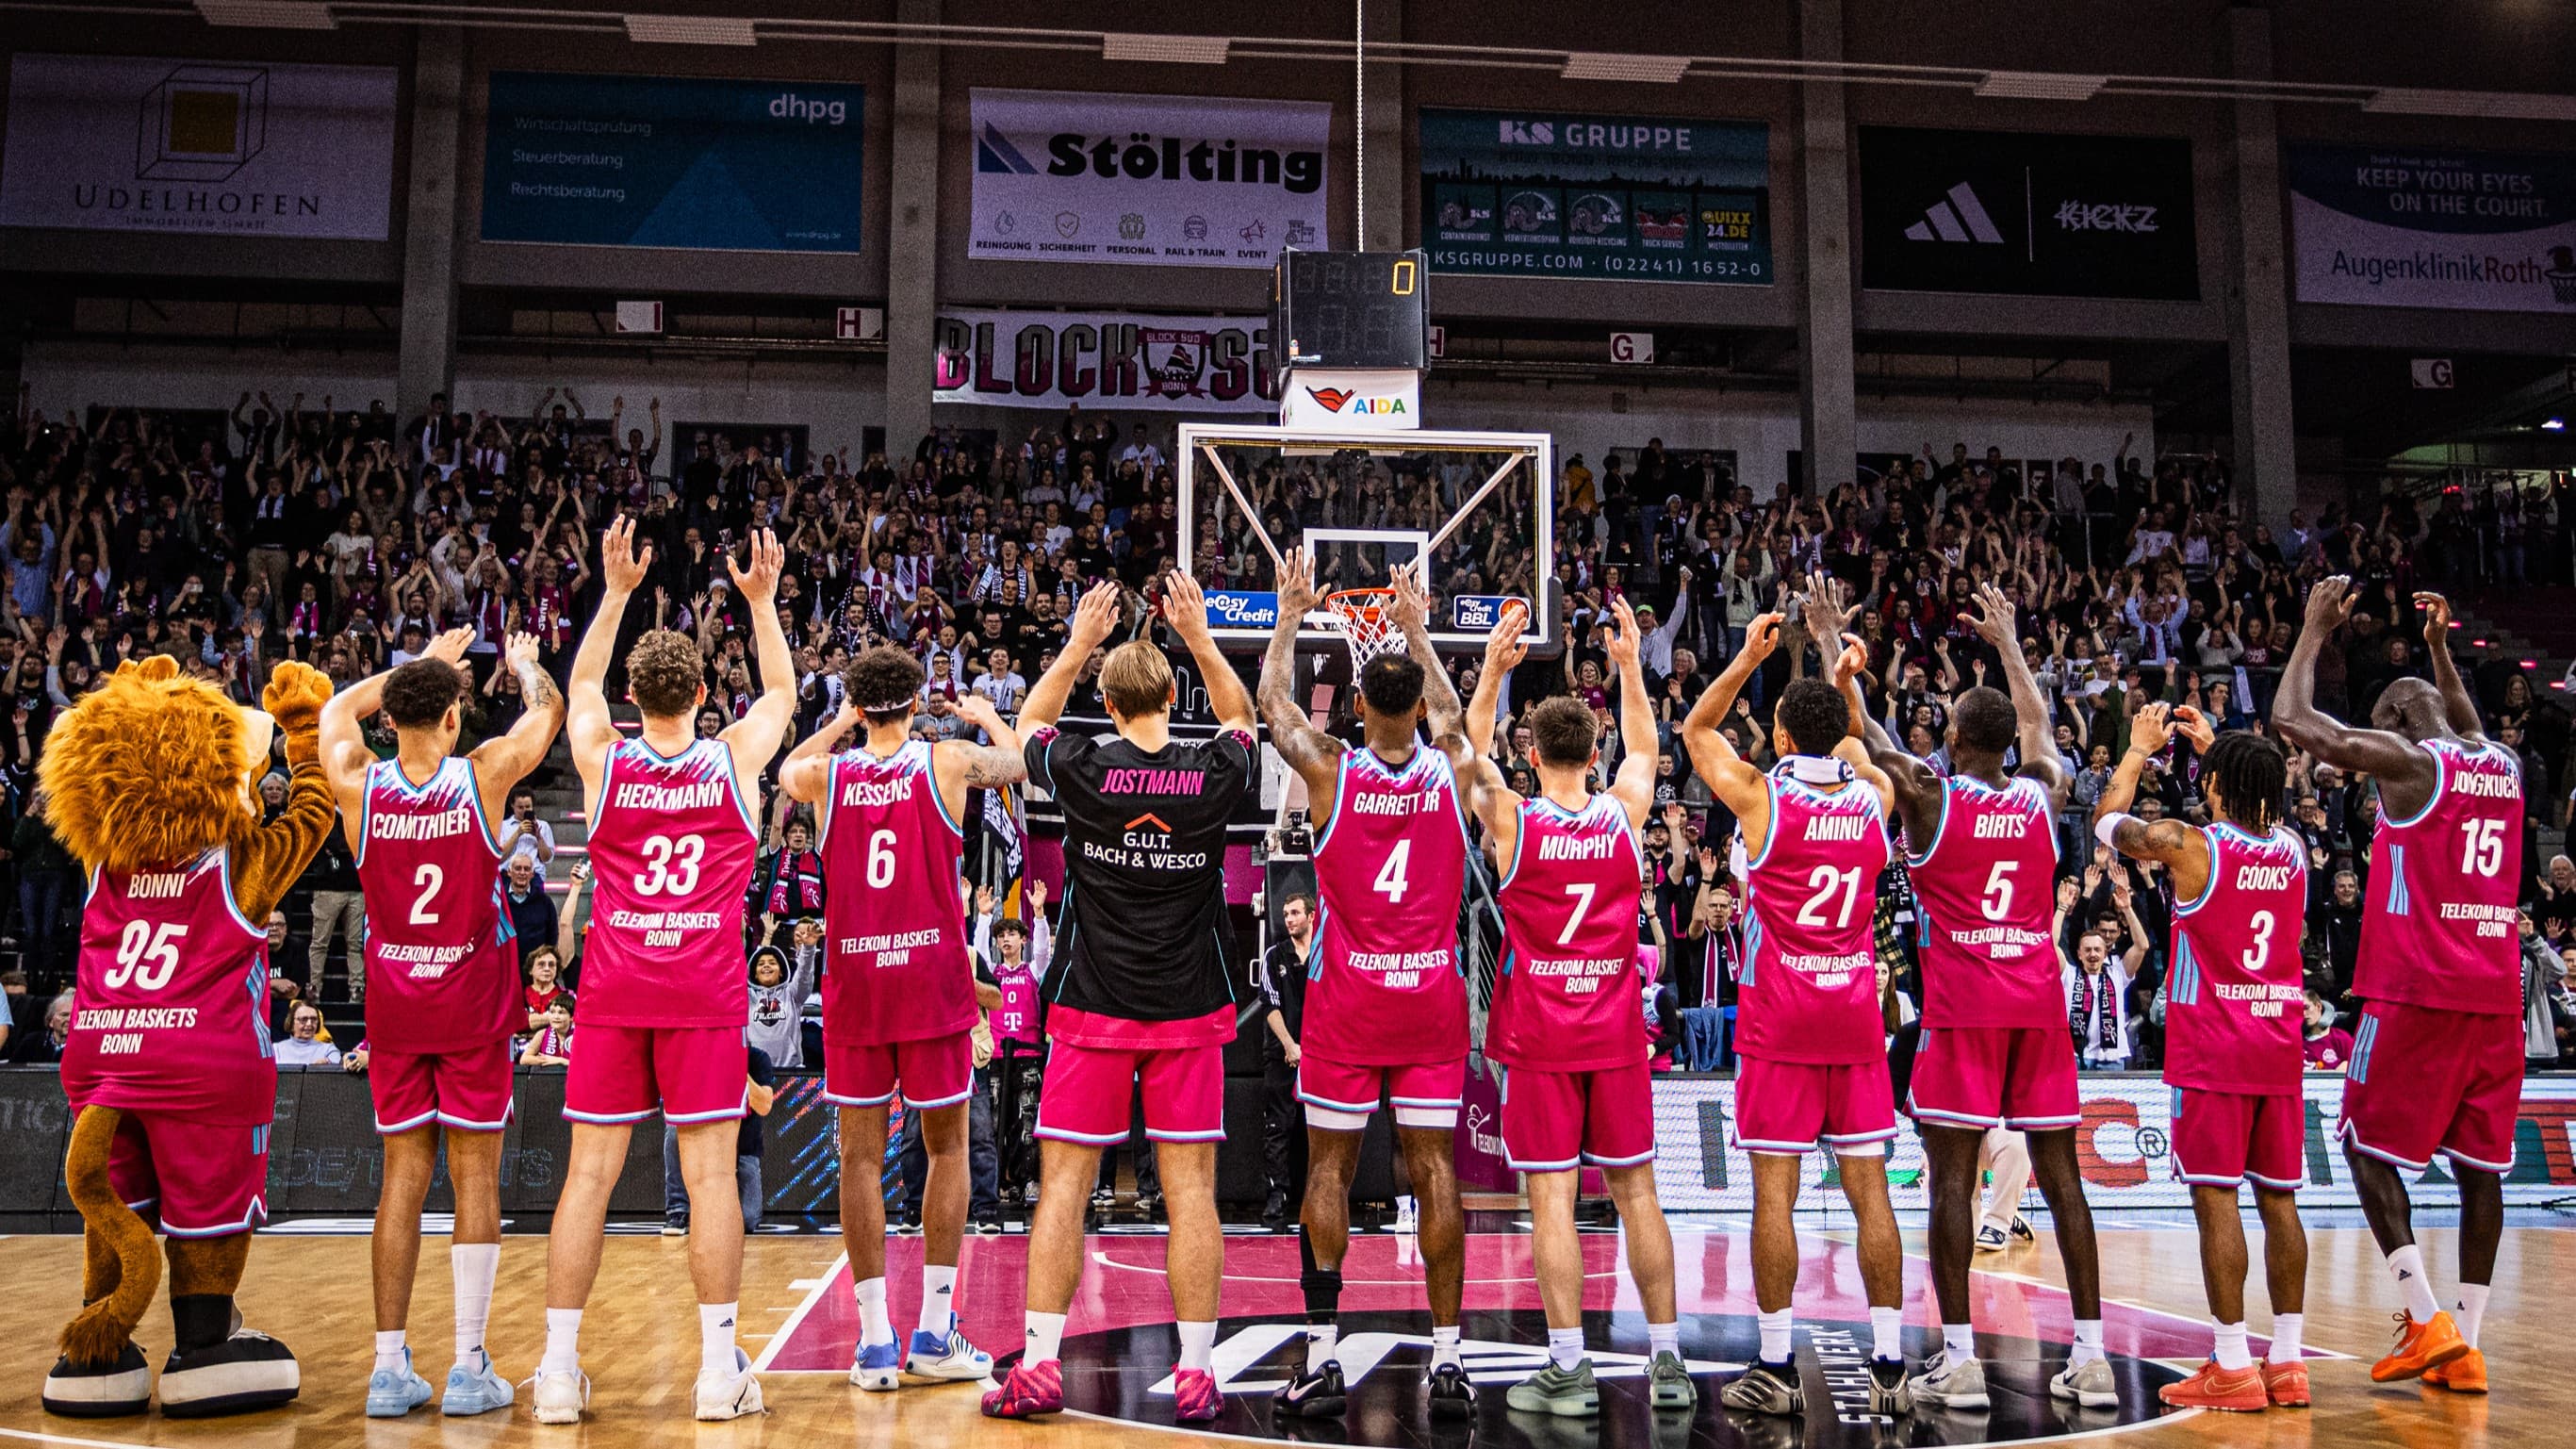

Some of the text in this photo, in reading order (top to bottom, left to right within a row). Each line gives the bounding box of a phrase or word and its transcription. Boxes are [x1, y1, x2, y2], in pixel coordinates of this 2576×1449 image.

[769, 93, 846, 125] dhpg
[514, 116, 652, 137] Wirtschaftsprüfung
[1500, 120, 1692, 151] KS GRUPPE
[512, 149, 624, 170] Steuerberatung
[1046, 132, 1322, 194] Stölting
[2356, 167, 2535, 195] KEEP YOUR EYES
[74, 183, 320, 217] UDELHOFEN
[510, 182, 626, 203] Rechtsberatung
[2389, 192, 2421, 212] ON
[2427, 194, 2467, 215] THE
[1701, 210, 1752, 224] QUIXX
[1706, 224, 1749, 239] 24.DE
[976, 240, 1031, 252] REINIGUNG
[1039, 242, 1096, 254] SICHERHEIT
[1107, 245, 1157, 255] PERSONAL
[1165, 247, 1186, 257] RAIL
[1197, 248, 1225, 258] TRAIN
[1238, 249, 1267, 259] EVENT
[1435, 250, 1761, 276] KSGRUPPE.COM (02241) 1652-0
[1391, 260, 1416, 296] 0
[839, 309, 861, 338] H
[1146, 332, 1176, 343] BLOCK
[935, 317, 1139, 397] BLOCK
[1612, 335, 1634, 362] G
[2431, 360, 2452, 387] G
[1161, 381, 1189, 392] BONN
[1353, 398, 1406, 414] AIDA
[1206, 594, 1250, 612] e@sy
[1225, 608, 1275, 622] Credit
[1460, 612, 1492, 625] BBL
[842, 776, 913, 807] KESSENS
[1100, 768, 1205, 796] JOSTMANN
[615, 782, 725, 810] HECKMANN
[1353, 790, 1440, 816] GARRETT JR
[1803, 815, 1865, 841] AMINU
[1973, 813, 2026, 838] BIRTS
[1124, 832, 1172, 849] G.U.T.
[1538, 834, 1617, 861] MURPHY
[2461, 817, 2506, 878] 15
[633, 834, 706, 897] 33
[866, 829, 897, 889] 6
[1084, 842, 1206, 870] BACH & WESCO
[1372, 838, 1411, 903] 4
[2236, 864, 2290, 891] COOKS
[127, 873, 189, 898] BONNI
[409, 864, 444, 926] 2
[1981, 860, 2019, 921] 5
[1796, 864, 1862, 929] 21
[609, 910, 720, 929] TELEKOM BASKETS
[1556, 882, 1597, 946] 7
[2440, 902, 2494, 920] TELEKOM
[645, 930, 683, 947] BONN
[1950, 928, 2005, 944] TELEKOM
[2476, 920, 2507, 938] BONN
[840, 928, 941, 954] TELEKOM BASKETS
[2242, 910, 2275, 971] 3
[104, 919, 189, 991] 95
[377, 943, 433, 962] TELEKOM
[876, 949, 910, 968] BONN
[1347, 950, 1401, 971] TELEKOM
[1780, 950, 1833, 973] TELEKOM
[1990, 944, 2024, 959] BONN
[409, 963, 449, 979] BONN
[1528, 959, 1584, 976] TELEKOM
[1384, 971, 1420, 988] BONN
[1565, 977, 1600, 994] BONN
[1815, 972, 1850, 987] BONN
[1008, 991, 1017, 1004] 0
[2214, 982, 2304, 1001] TELEKOM BASKETS
[124, 1008, 199, 1029] BASKETS
[2250, 1001, 2283, 1017] BONN
[100, 1033, 144, 1055] BONN
